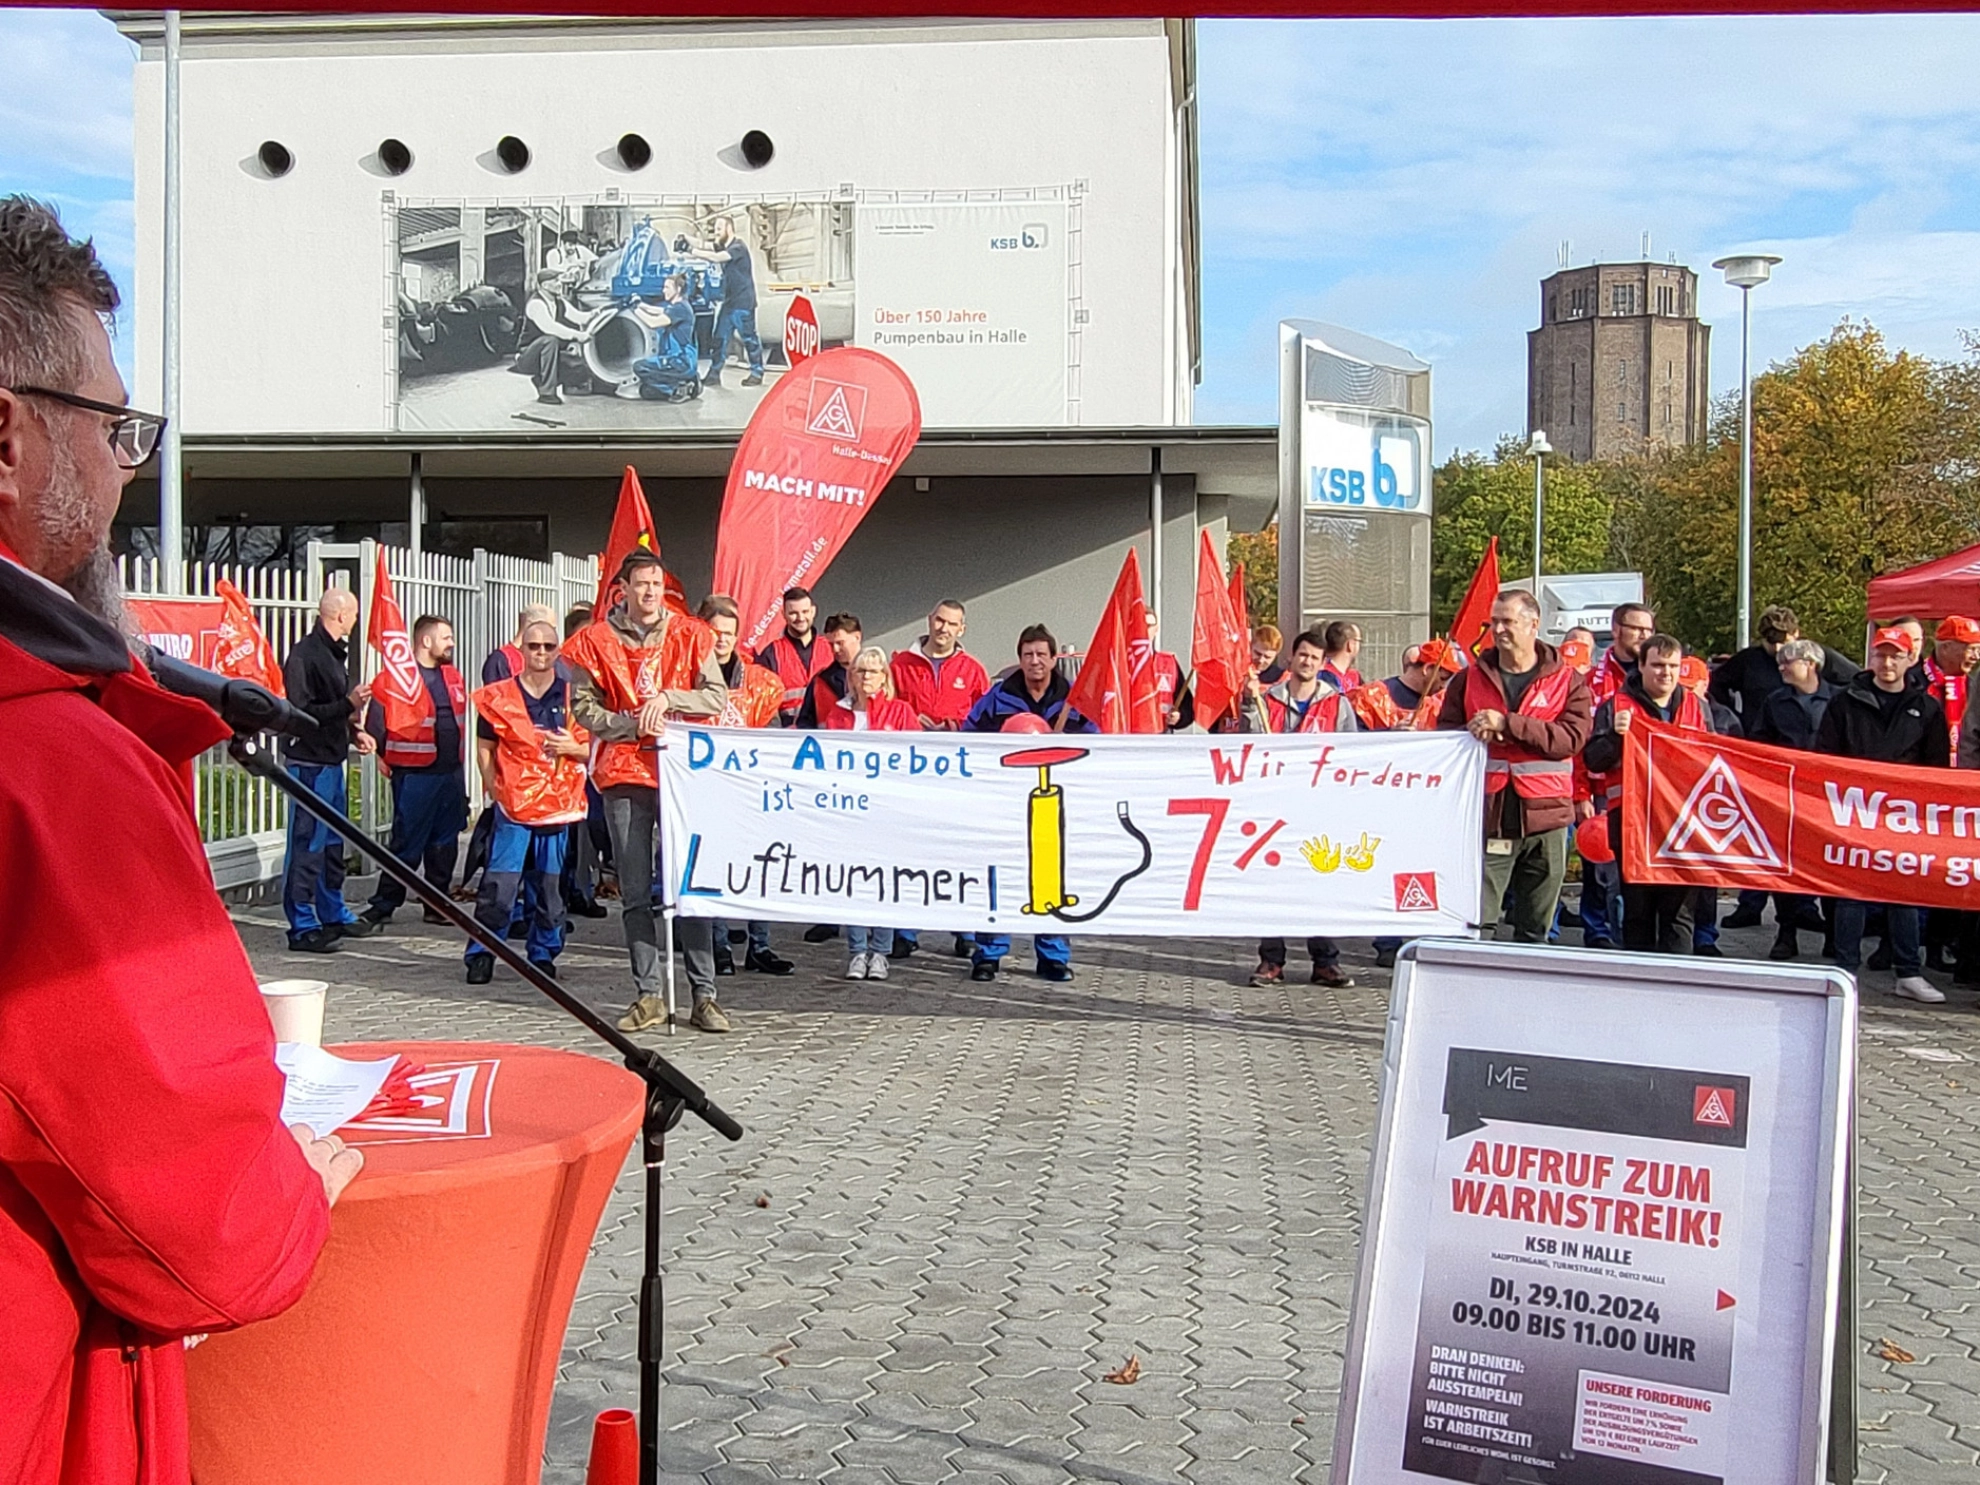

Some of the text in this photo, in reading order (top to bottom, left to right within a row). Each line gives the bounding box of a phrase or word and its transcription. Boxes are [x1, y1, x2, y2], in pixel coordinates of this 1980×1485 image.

[990, 238, 1018, 249] KSB
[874, 308, 987, 324] Über 150 Jahre
[787, 316, 817, 357] STOP
[874, 330, 1027, 347] Pumpenbau in Halle
[744, 470, 865, 506] MACH MIT!
[1311, 466, 1365, 505] KSB
[792, 735, 974, 779] Angebot
[1209, 743, 1442, 789] Wir fordern
[762, 781, 869, 812] ist eine
[1824, 844, 1936, 876] unser
[679, 833, 998, 924] Luftnummer!
[1487, 1063, 1529, 1091] ME
[1464, 1140, 1711, 1203] AUFRUF ZUM
[1452, 1178, 1722, 1248] WARNSTREIK!
[1525, 1236, 1632, 1266] KSB IN HALLE
[1642, 1274, 1666, 1285] HALLE
[1490, 1277, 1660, 1324] DI, 29.10.2024
[1453, 1301, 1696, 1362] 09.00 BIS 11.00 UHR
[1430, 1361, 1507, 1387] BITTE NICHT
[1431, 1345, 1525, 1374] DRAN DENKEN:
[1427, 1377, 1523, 1407] AUSSTEMPELN!
[1586, 1379, 1712, 1413] UNSERE FORDERUNG
[1426, 1398, 1510, 1427] WARNSTREIK
[1583, 1408, 1597, 1417] DER
[1583, 1417, 1596, 1426] DER
[1424, 1414, 1533, 1448] IST ARBEITSZEIT!
[1421, 1436, 1435, 1445] FÜR
[1511, 1454, 1522, 1463] IST
